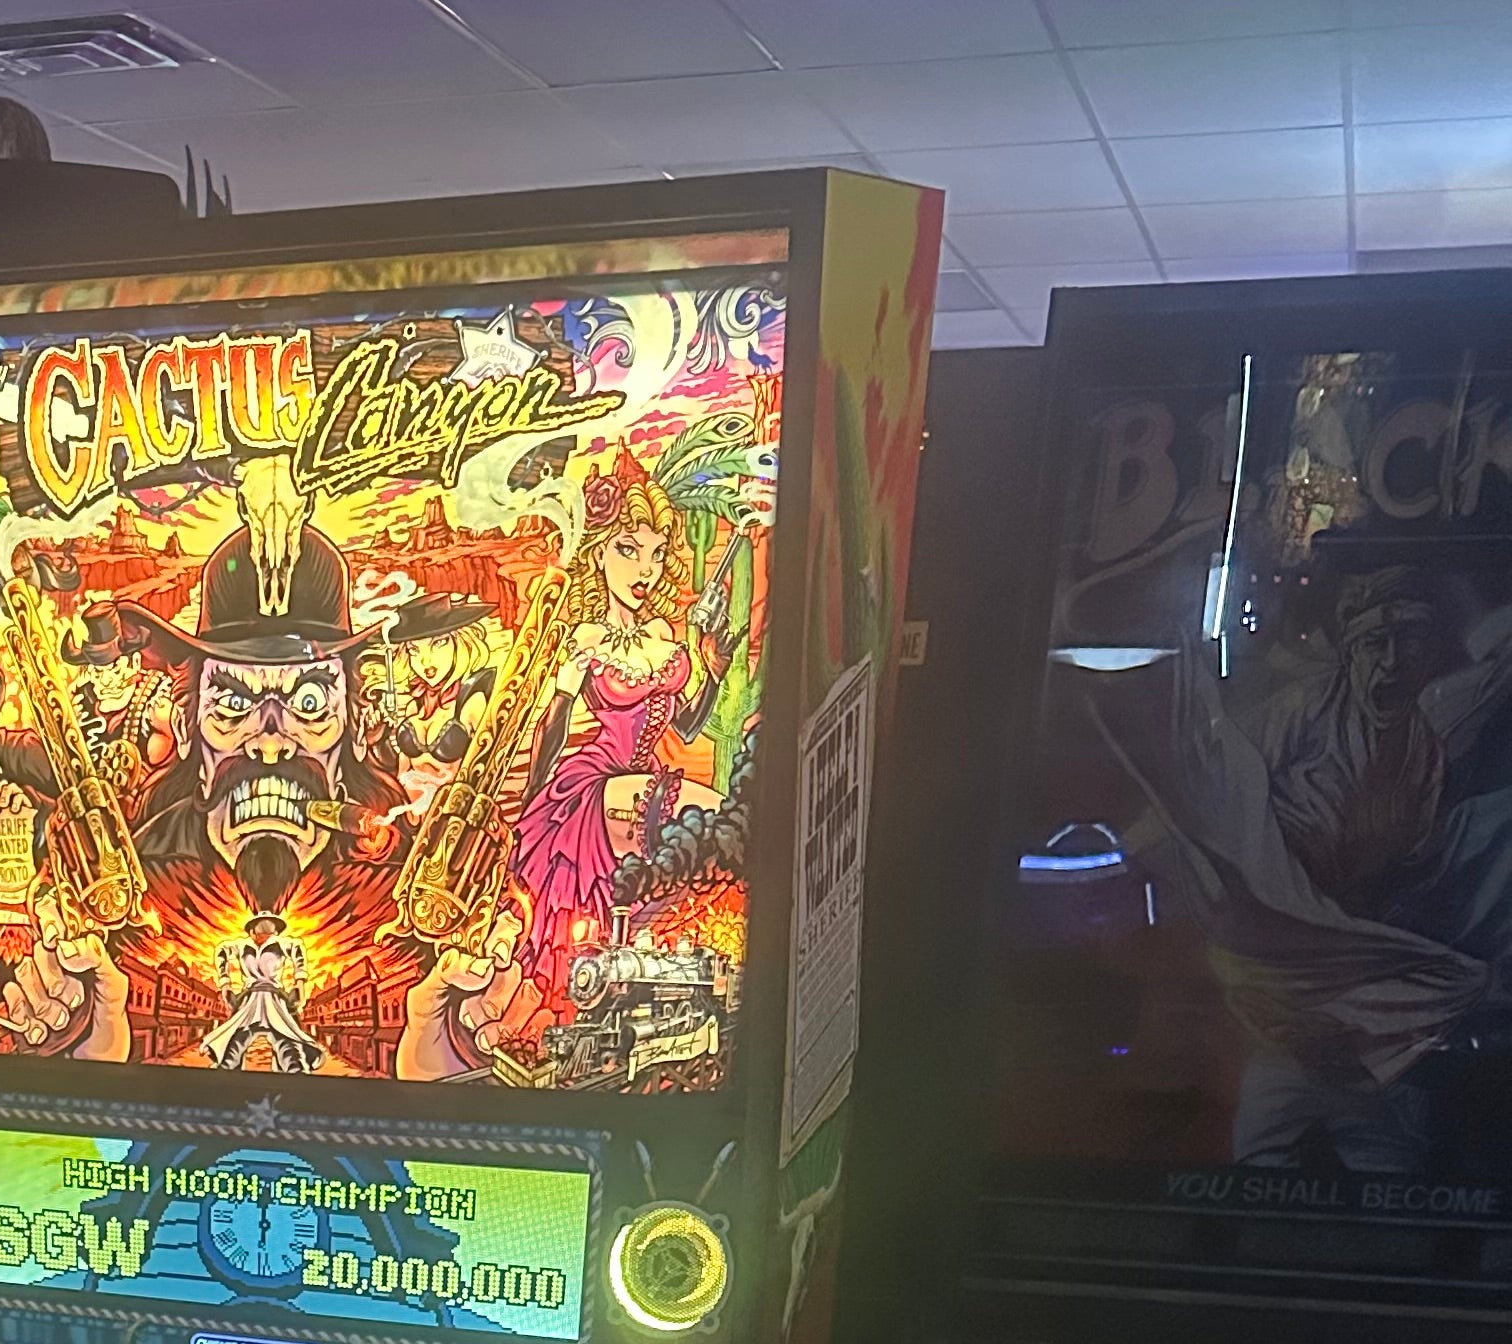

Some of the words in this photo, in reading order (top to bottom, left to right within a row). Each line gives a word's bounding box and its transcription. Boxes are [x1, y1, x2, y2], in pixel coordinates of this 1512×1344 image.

[26, 331, 314, 512] CACTUS
[293, 338, 624, 492] Canyon
[63, 1158, 150, 1193] HIGH
[165, 1166, 260, 1202] NOON
[275, 1176, 477, 1221] CHAMPION
[1165, 1173, 1234, 1200] YOU
[1241, 1176, 1346, 1207] SHALL
[1360, 1182, 1503, 1214] BECOME
[301, 1248, 566, 1309] 20,000,000
